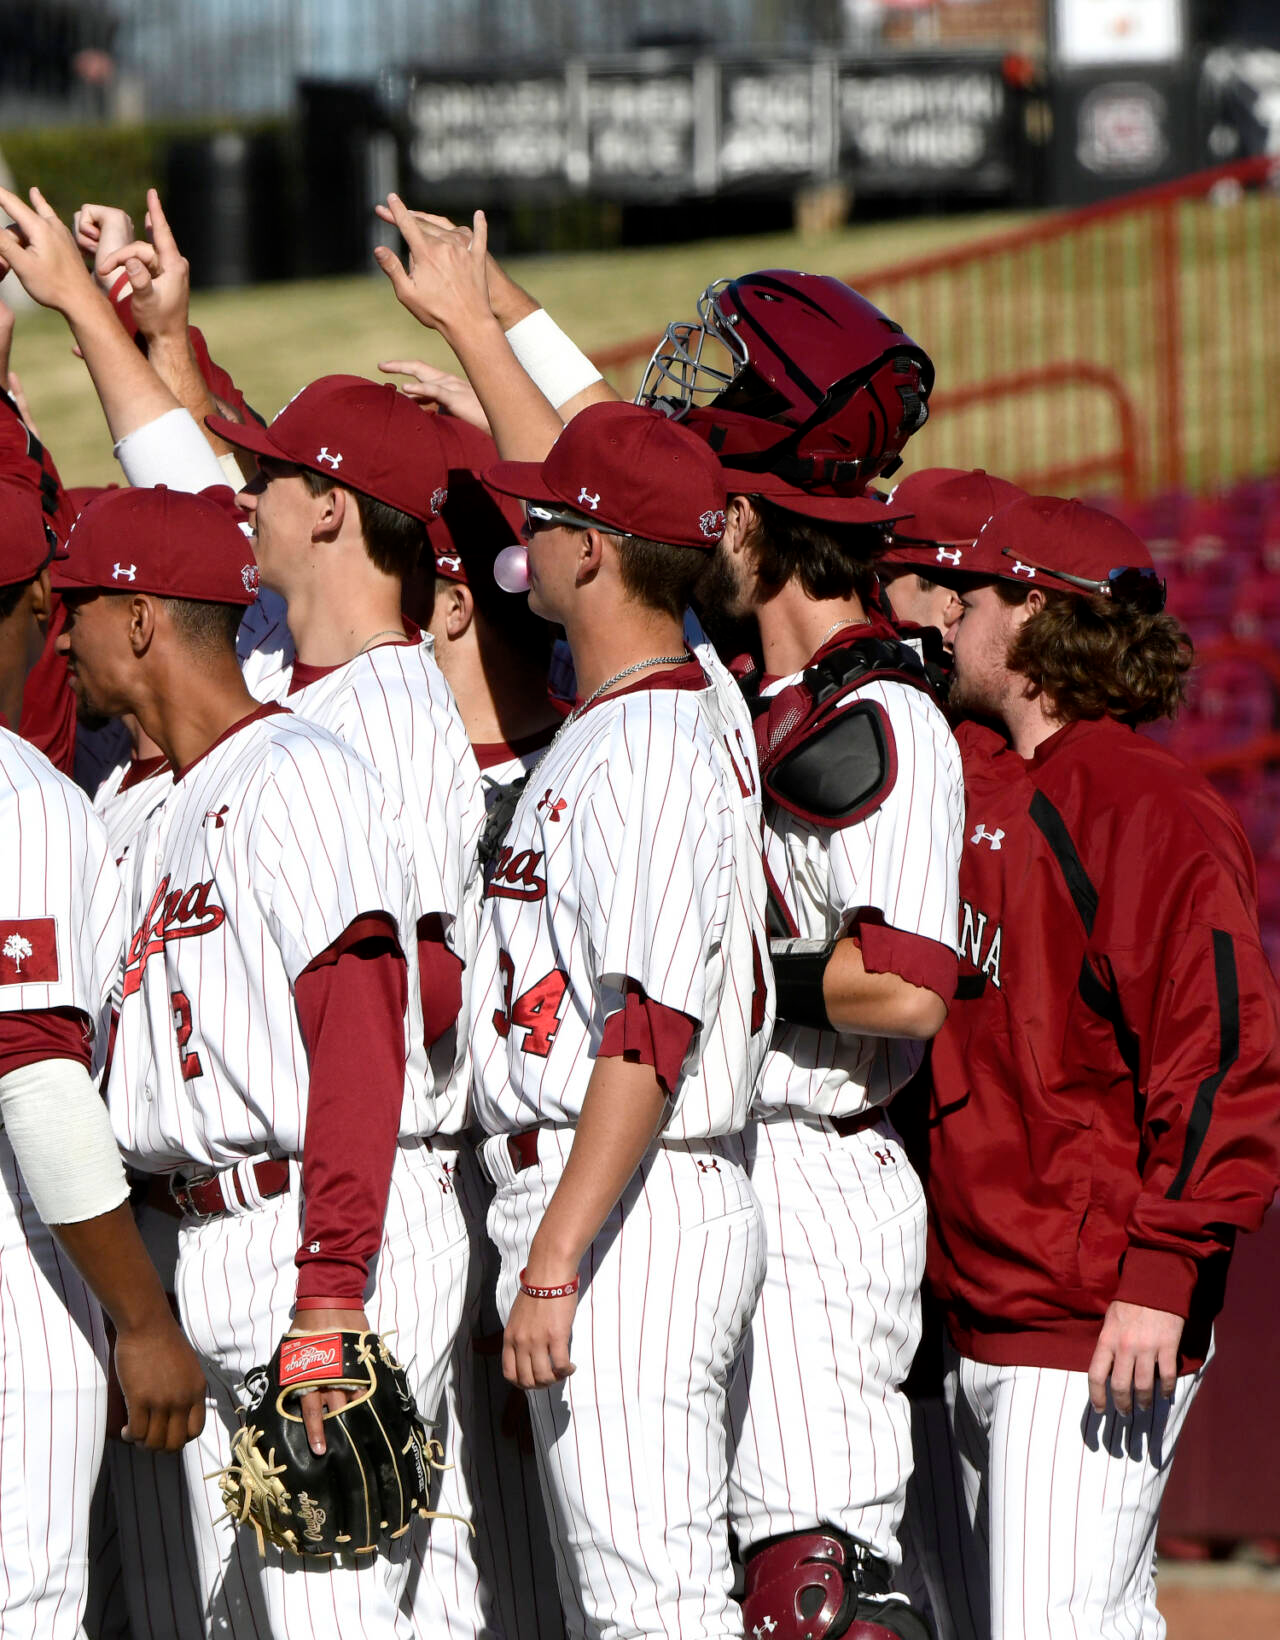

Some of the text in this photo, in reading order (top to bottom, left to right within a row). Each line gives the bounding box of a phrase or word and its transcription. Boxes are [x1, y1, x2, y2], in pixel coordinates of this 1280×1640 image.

[538, 1289, 549, 1297] 27
[550, 1287, 563, 1296] 90
[284, 1347, 336, 1373] Rawlings
[297, 1490, 324, 1541] Rawlings
